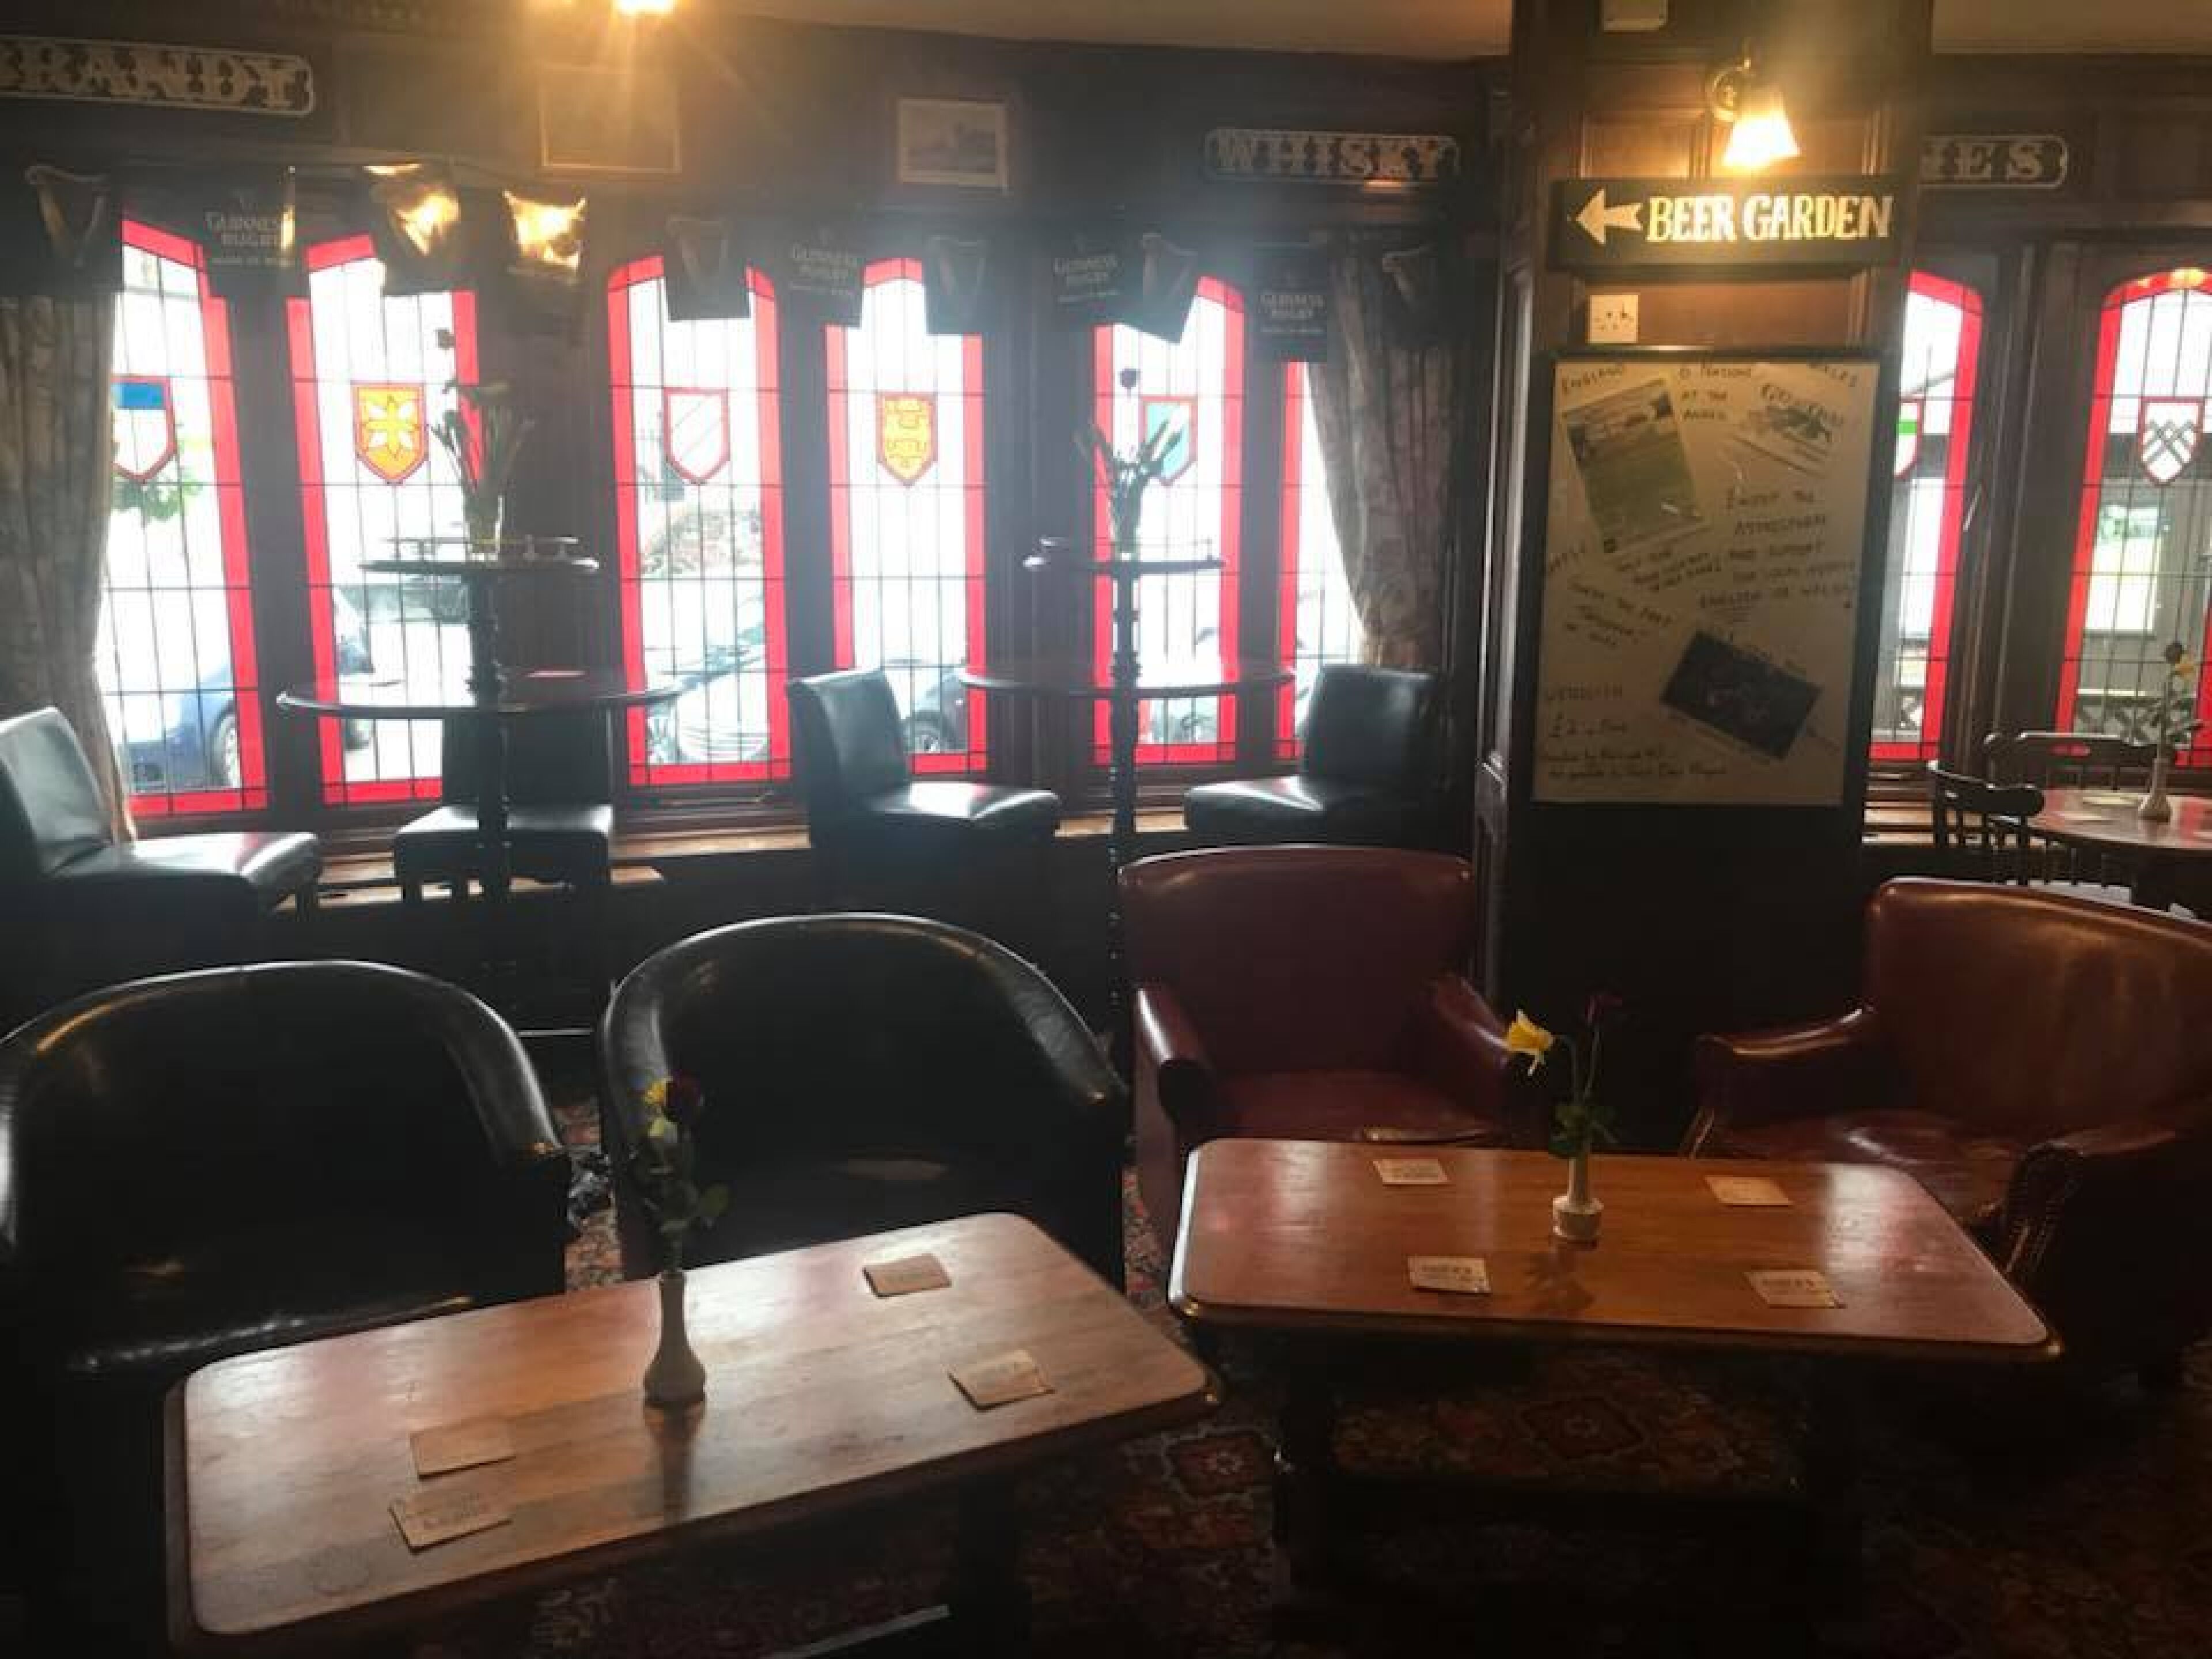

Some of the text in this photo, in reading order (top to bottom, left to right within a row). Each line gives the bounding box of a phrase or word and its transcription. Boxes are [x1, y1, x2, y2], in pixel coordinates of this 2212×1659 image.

[1214, 131, 1440, 179] WHISKY
[1646, 193, 1895, 242] BEER GARDEN
